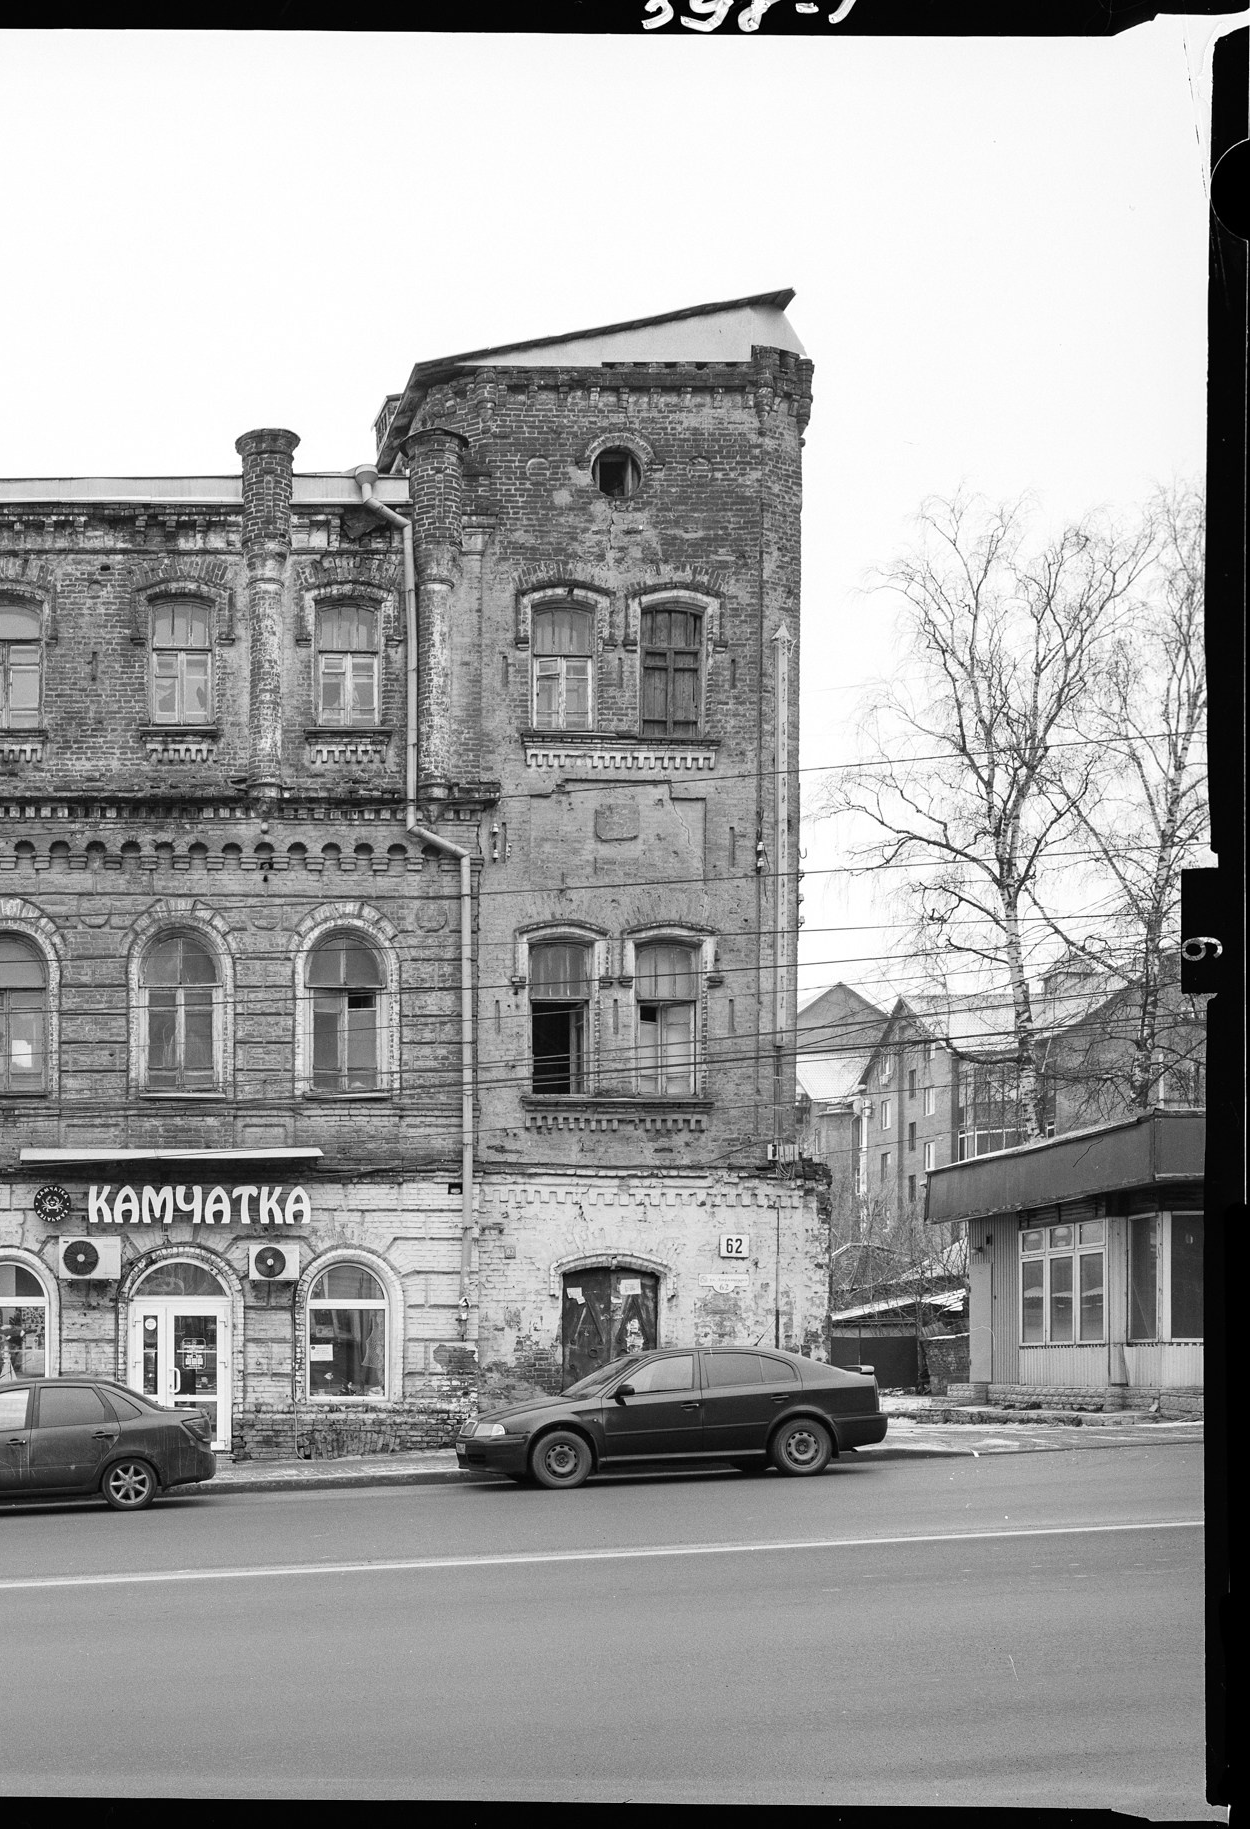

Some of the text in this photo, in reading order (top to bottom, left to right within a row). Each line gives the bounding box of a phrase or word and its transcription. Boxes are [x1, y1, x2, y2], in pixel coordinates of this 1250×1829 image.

[36, 1186, 69, 1199] КАМЧАТКА
[87, 1185, 312, 1224] КАМЧАТКА
[726, 1238, 743, 1254] 62
[719, 1283, 729, 1291] 62
